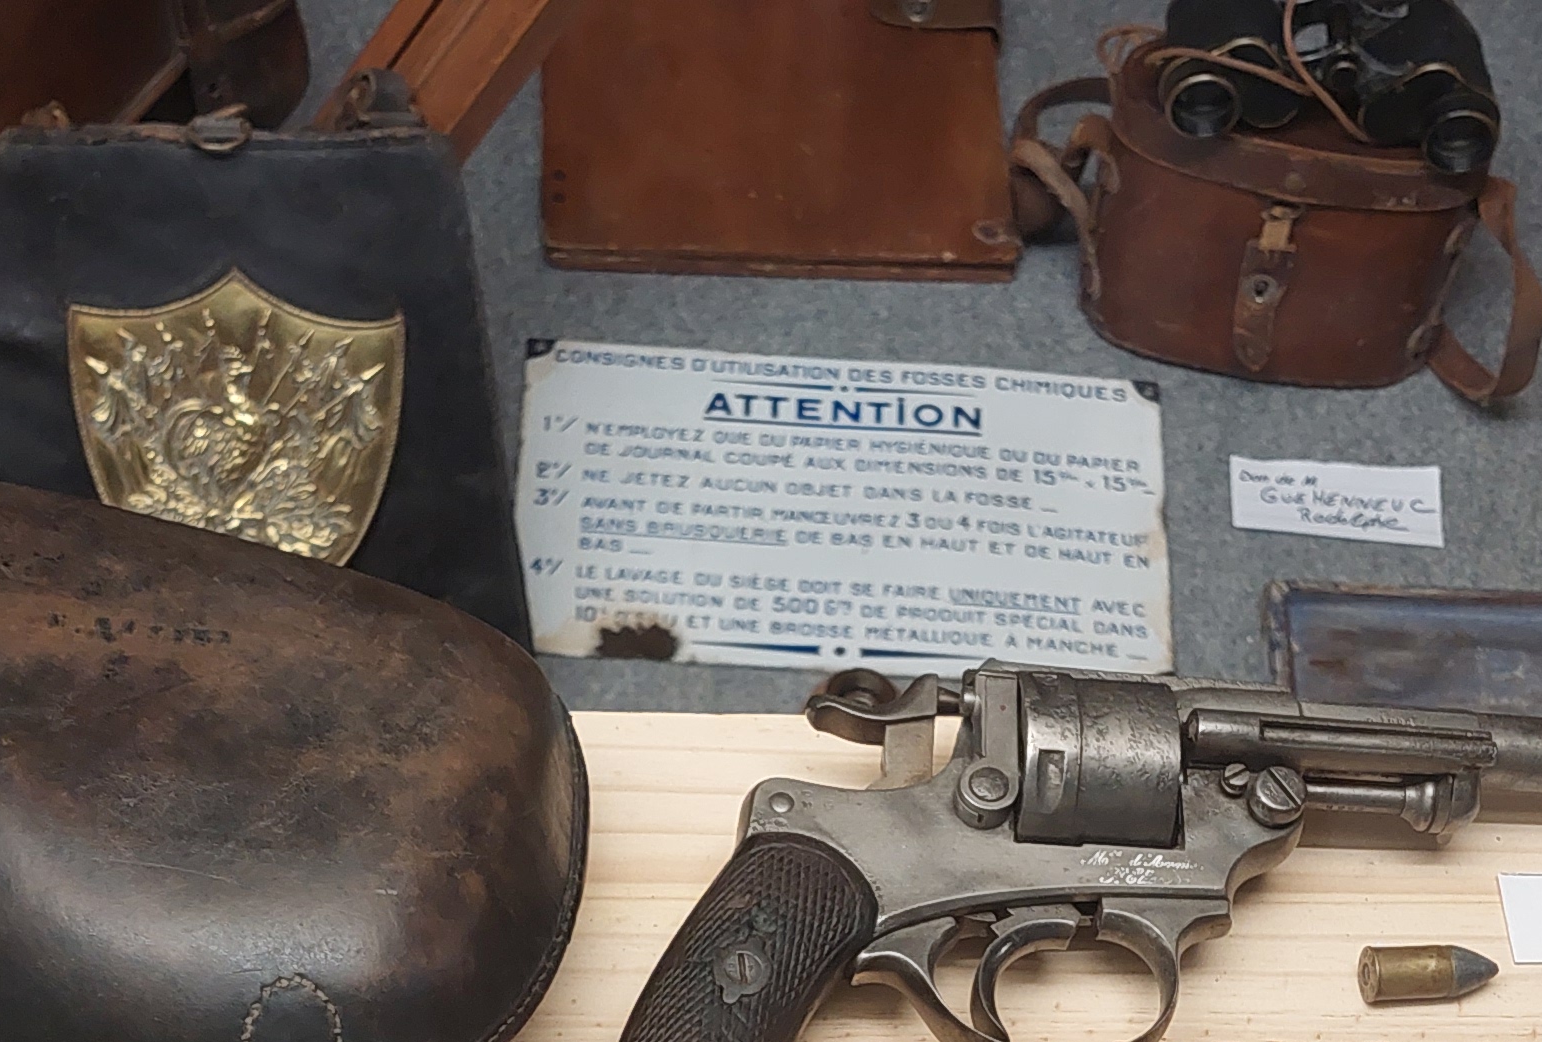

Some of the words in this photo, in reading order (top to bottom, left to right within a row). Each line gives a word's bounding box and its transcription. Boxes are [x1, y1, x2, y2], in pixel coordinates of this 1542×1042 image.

[555, 349, 686, 371] CONSIGNES
[847, 367, 893, 384] DES
[901, 370, 987, 389] FOSSES
[994, 376, 1128, 402] CHIMIQUES
[584, 442, 611, 456] DE
[618, 445, 715, 463] JOURNAL
[804, 457, 846, 471] AUX
[854, 459, 988, 479] DIMENSIONS
[995, 467, 1023, 482] DE
[790, 435, 861, 451] PAPIER
[999, 448, 1028, 463] OU
[1032, 450, 1061, 466] DU
[1066, 453, 1140, 473] PAPIER
[582, 469, 610, 484] NE
[618, 471, 690, 489] JETEZ
[700, 477, 778, 494] AUCUN
[785, 481, 853, 498] OBJET
[863, 485, 923, 501] DANS
[931, 489, 958, 503] LA
[964, 491, 1032, 510] FOSSE
[581, 496, 647, 511] AVANT
[655, 501, 684, 515] DE
[691, 502, 763, 518] PARTIR
[906, 512, 921, 528] 3
[924, 515, 953, 530] OU
[956, 515, 971, 531] 4
[976, 519, 1021, 536] FOIS
[578, 536, 623, 552] BAS
[580, 516, 638, 533] SANS
[646, 520, 788, 543] BRUSQUERIE
[795, 530, 823, 545] DE
[830, 531, 874, 547] BAS
[882, 534, 912, 549] EN
[920, 537, 979, 552] HAUT
[988, 540, 1016, 555] ET
[1024, 544, 1052, 560] DE
[1058, 548, 1112, 565] HAUT
[1123, 553, 1150, 569] EN
[574, 586, 612, 601] UNE
[623, 589, 723, 608] SOLUTION
[733, 596, 761, 612] DE
[772, 596, 819, 615] 500
[860, 604, 887, 620] DE
[896, 605, 986, 624] PRODUIT
[1093, 620, 1148, 639] DANS
[575, 565, 597, 579] LE
[604, 567, 683, 585] LAVAGE
[693, 572, 723, 587] DU
[797, 579, 842, 595] DOIT
[849, 582, 874, 597] SE
[881, 584, 941, 600] FAIRE
[948, 588, 1082, 613] UNIQUEMENT
[1091, 598, 1147, 618] AVEC
[685, 614, 711, 629] ET
[718, 616, 760, 634] UNE
[769, 620, 853, 639] BROSSE
[1027, 636, 1119, 659] MANCHE
